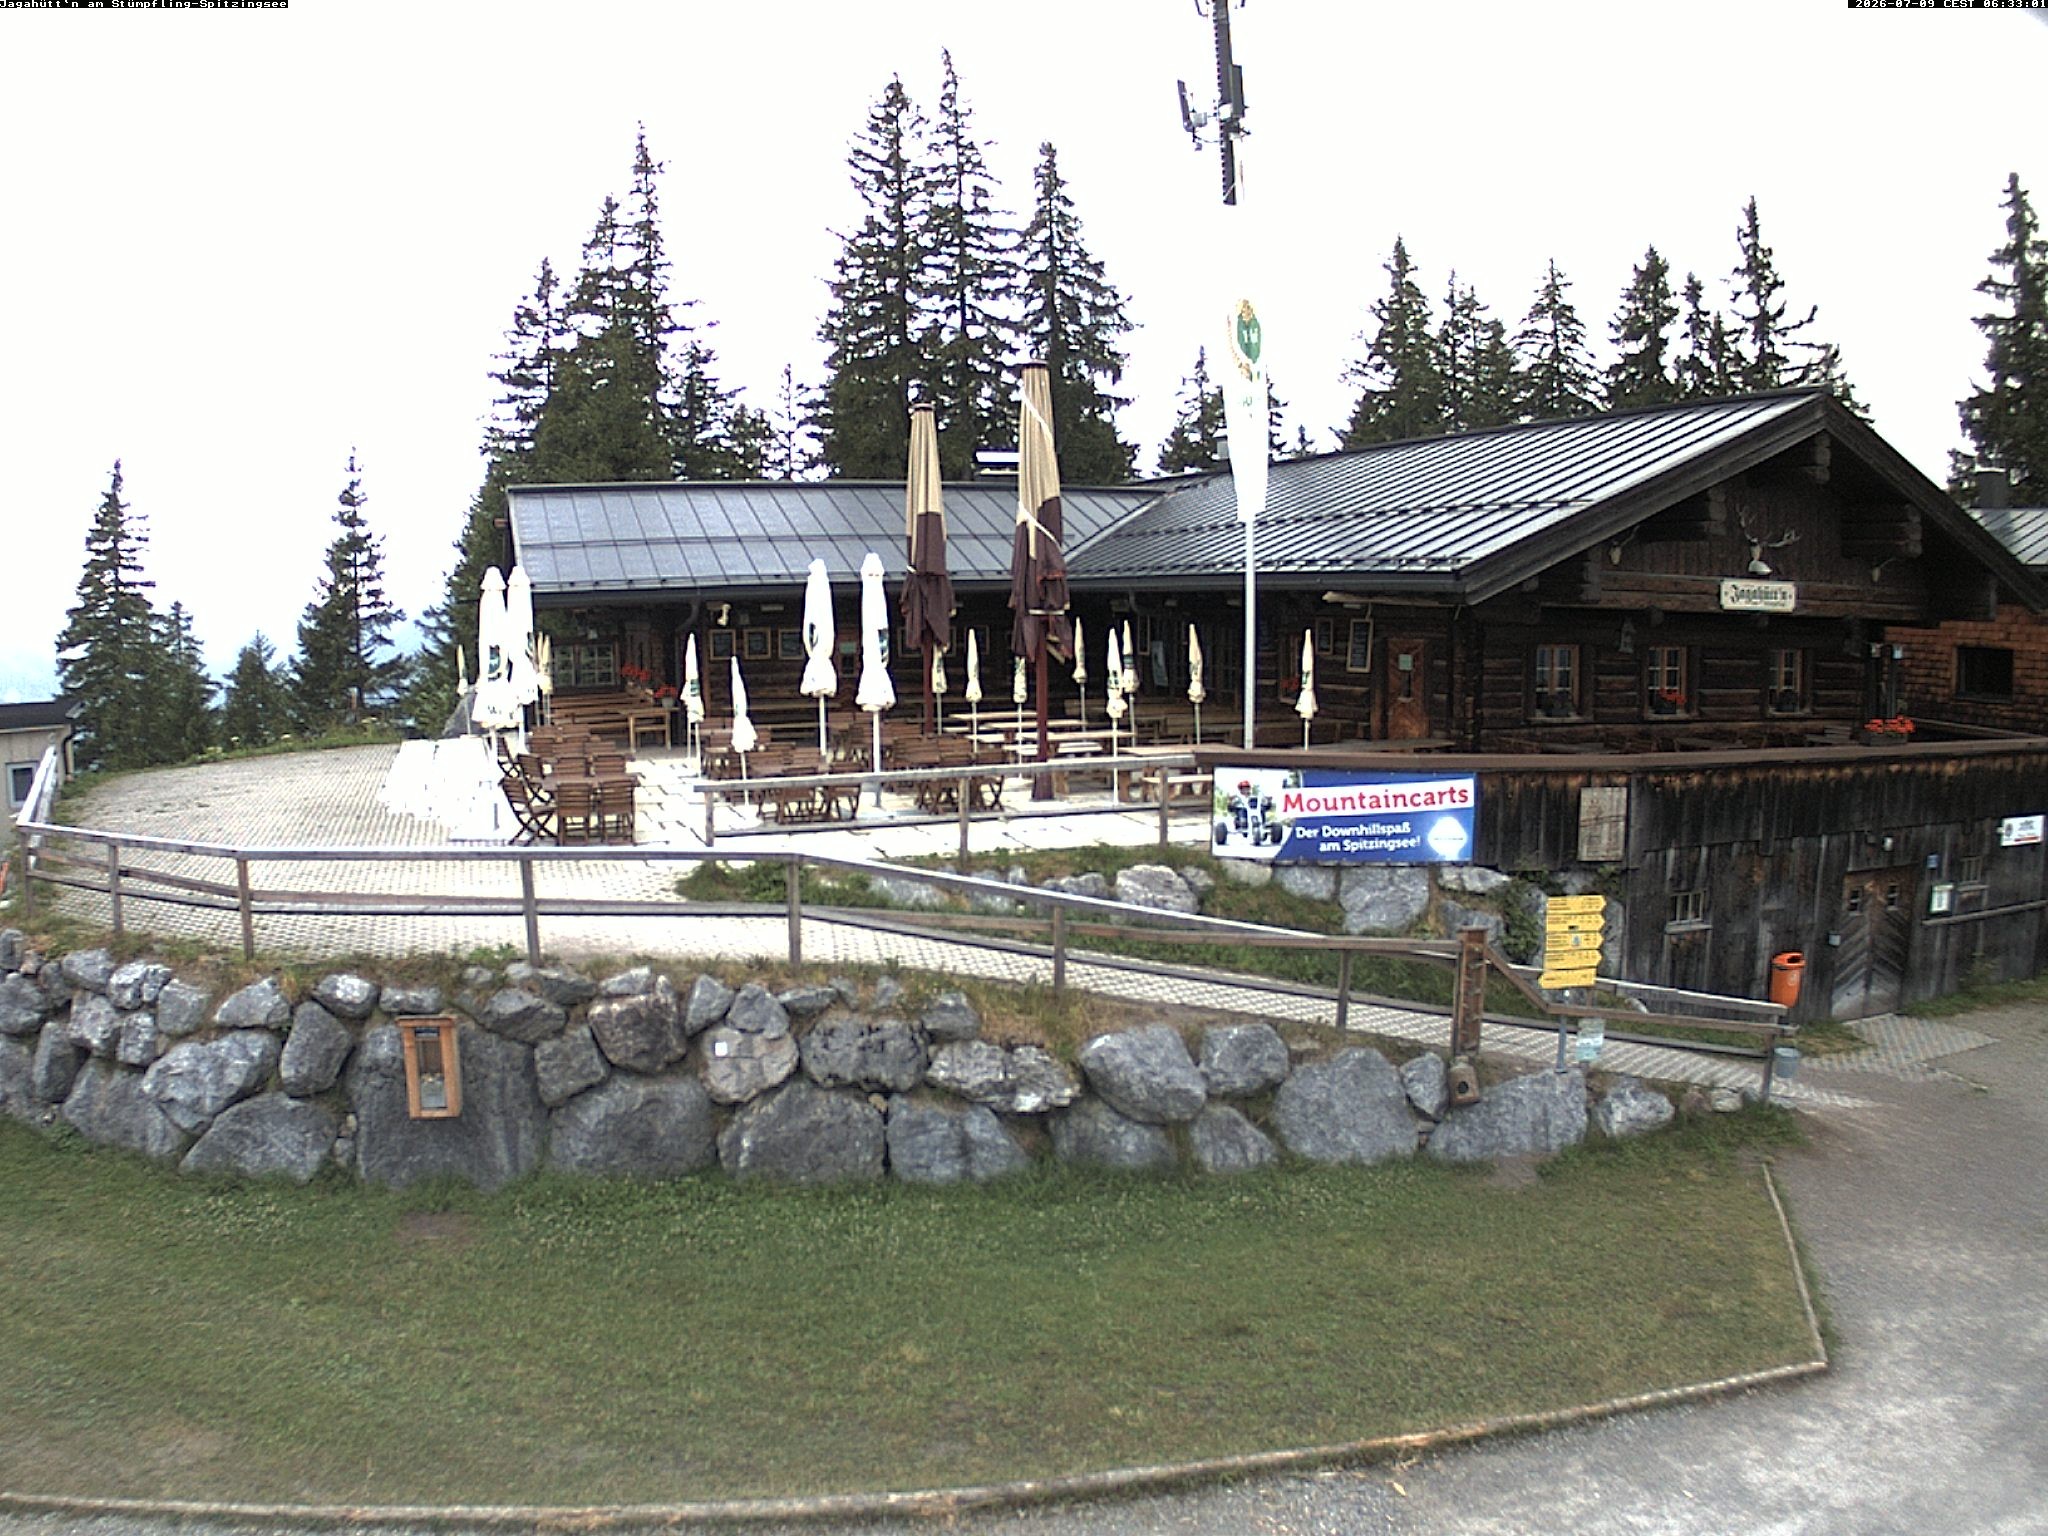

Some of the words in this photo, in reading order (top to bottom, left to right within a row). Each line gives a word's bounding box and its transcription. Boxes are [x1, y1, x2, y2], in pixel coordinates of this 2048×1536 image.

[1283, 786, 1469, 813] Mountaincarts
[1295, 826, 1319, 838] Der
[1321, 822, 1411, 839] Downhillspaß
[1319, 843, 1341, 852] am
[1343, 836, 1421, 853] Spitzingsee!
